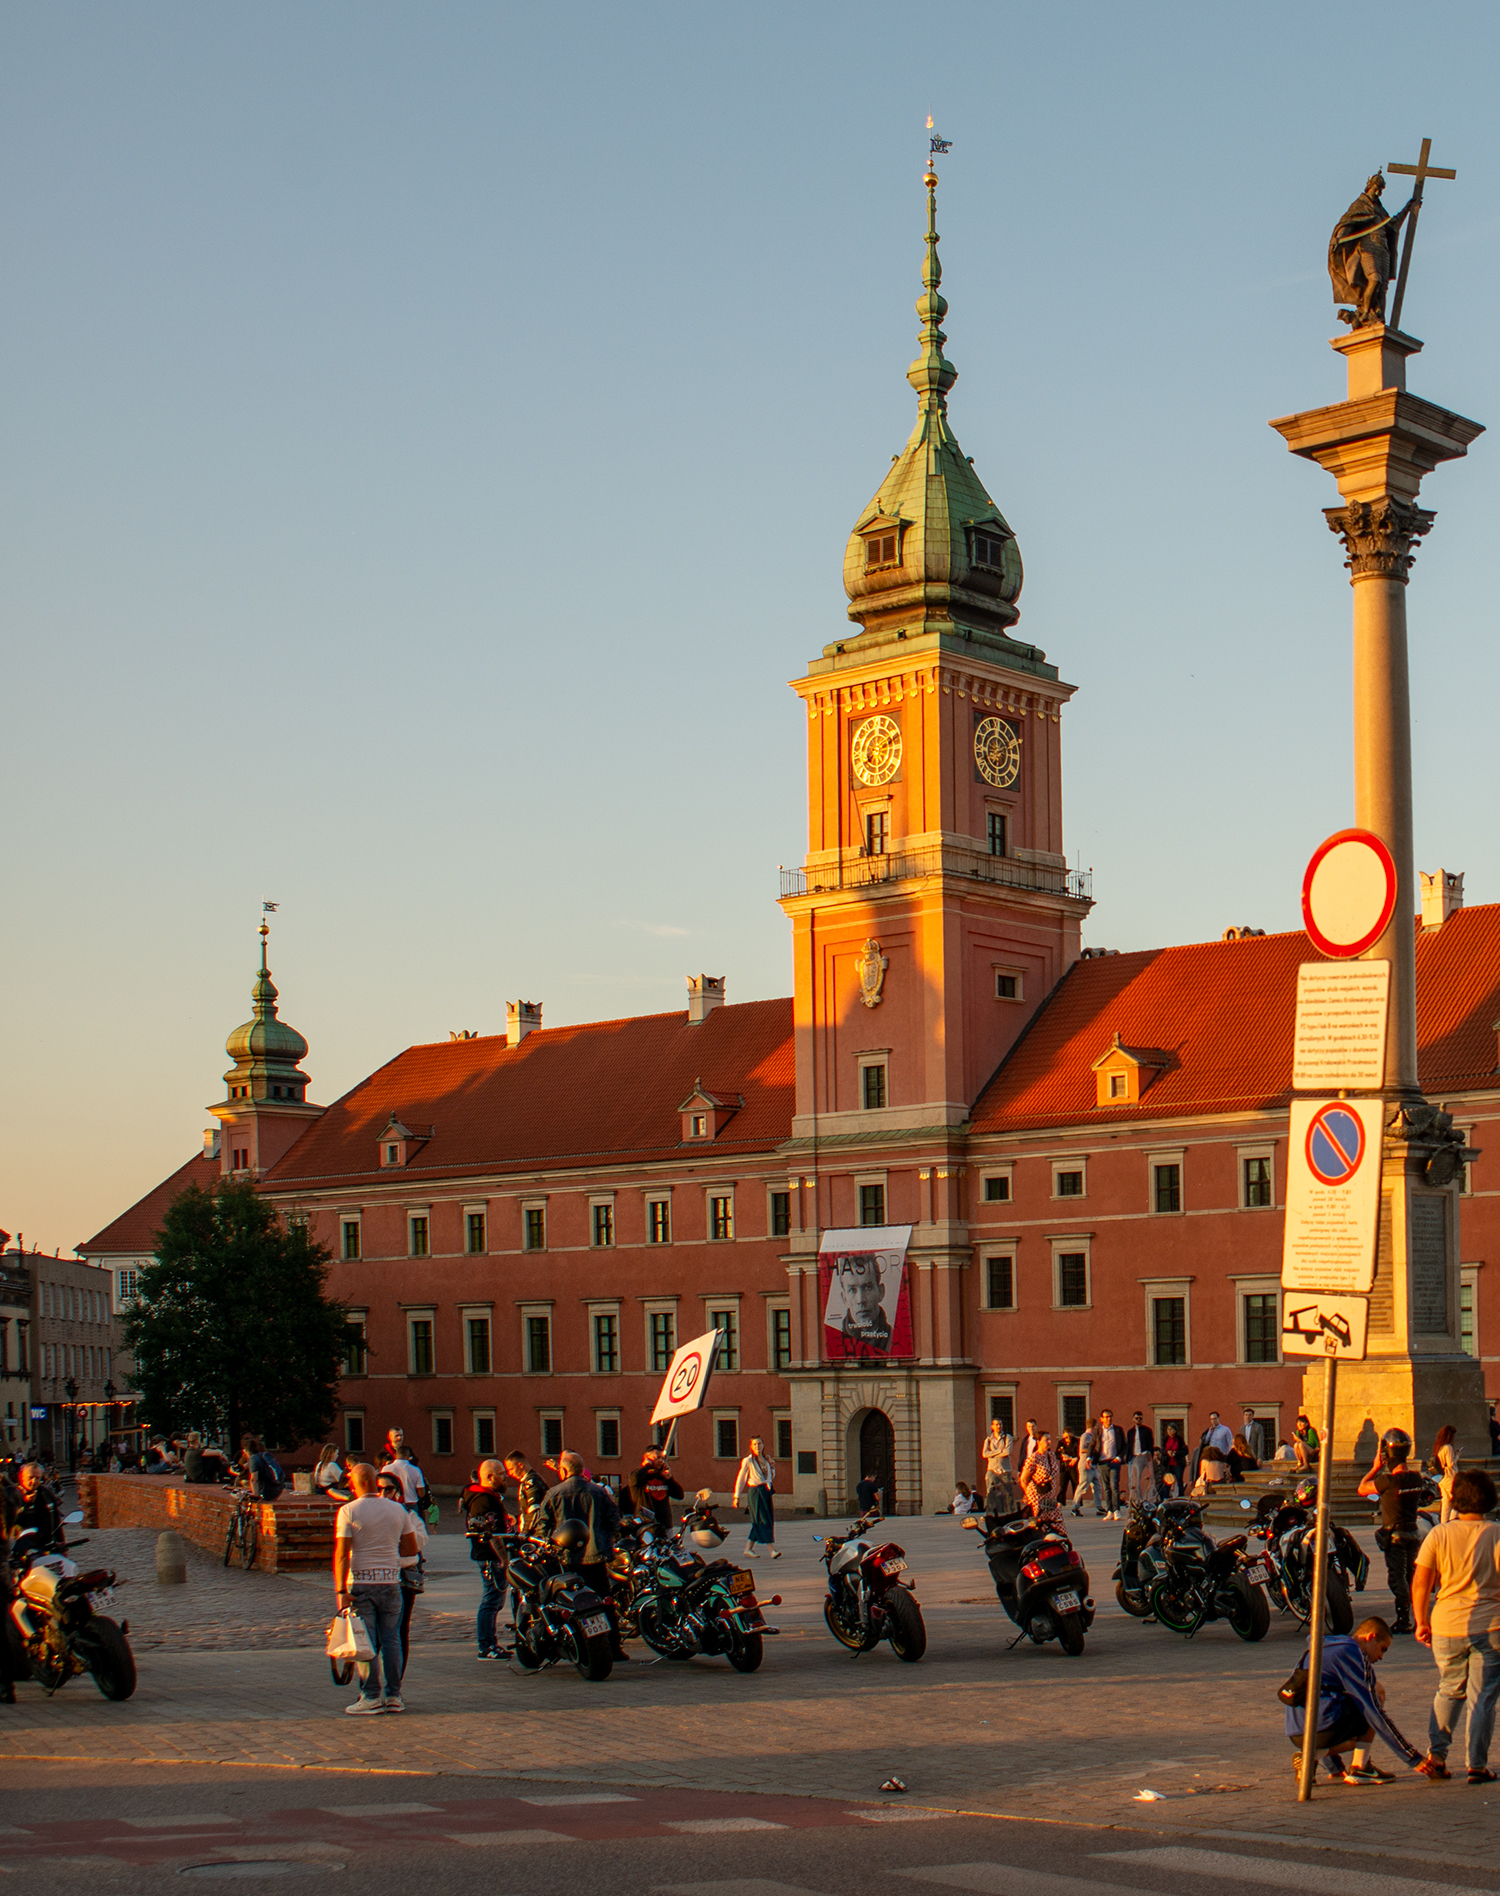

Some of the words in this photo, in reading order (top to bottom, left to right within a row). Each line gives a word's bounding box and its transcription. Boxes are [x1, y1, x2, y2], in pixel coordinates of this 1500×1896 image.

[827, 1254, 901, 1276] HASIOR
[674, 1363, 697, 1393] 20
[30, 1409, 46, 1418] WC
[735, 1574, 745, 1582] NE
